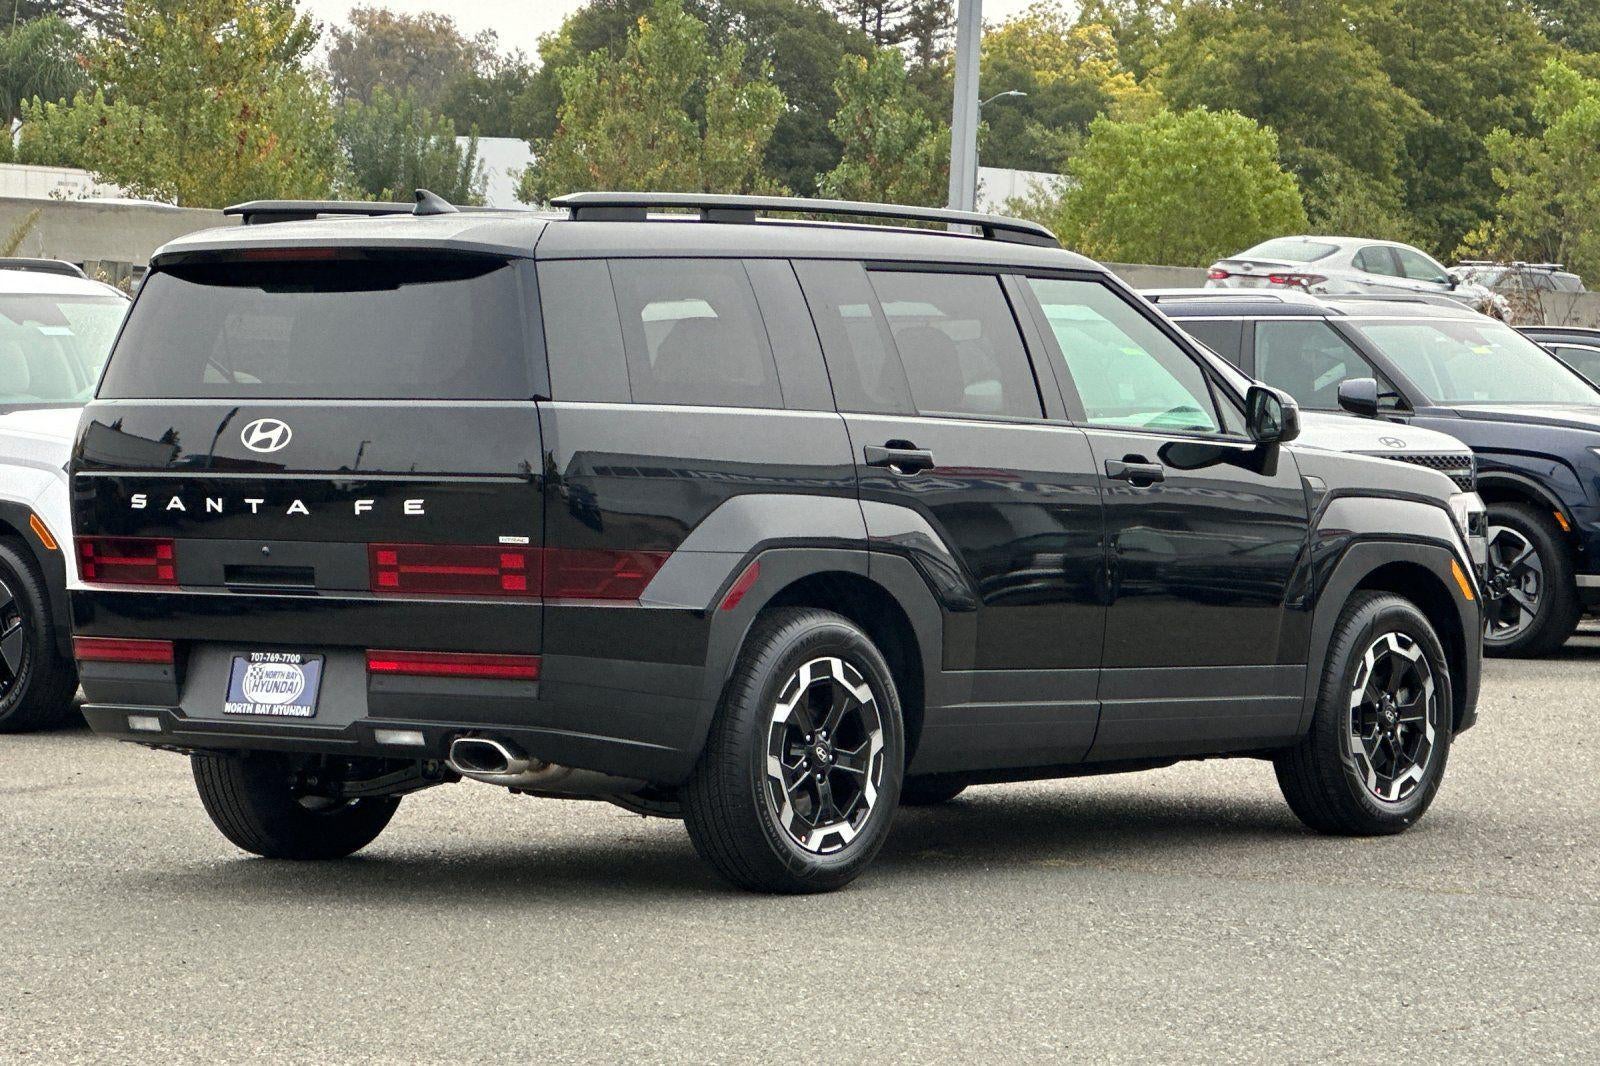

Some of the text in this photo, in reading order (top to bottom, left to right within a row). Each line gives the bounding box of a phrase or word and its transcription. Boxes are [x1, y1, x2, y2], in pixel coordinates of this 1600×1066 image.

[131, 494, 425, 515] SANTA FE
[250, 652, 301, 663] 707-769-7700
[264, 670, 298, 679] NORTH BAY
[252, 681, 299, 693] HYUNDAI
[224, 702, 311, 716] NORTH BAY HYUNDAI
